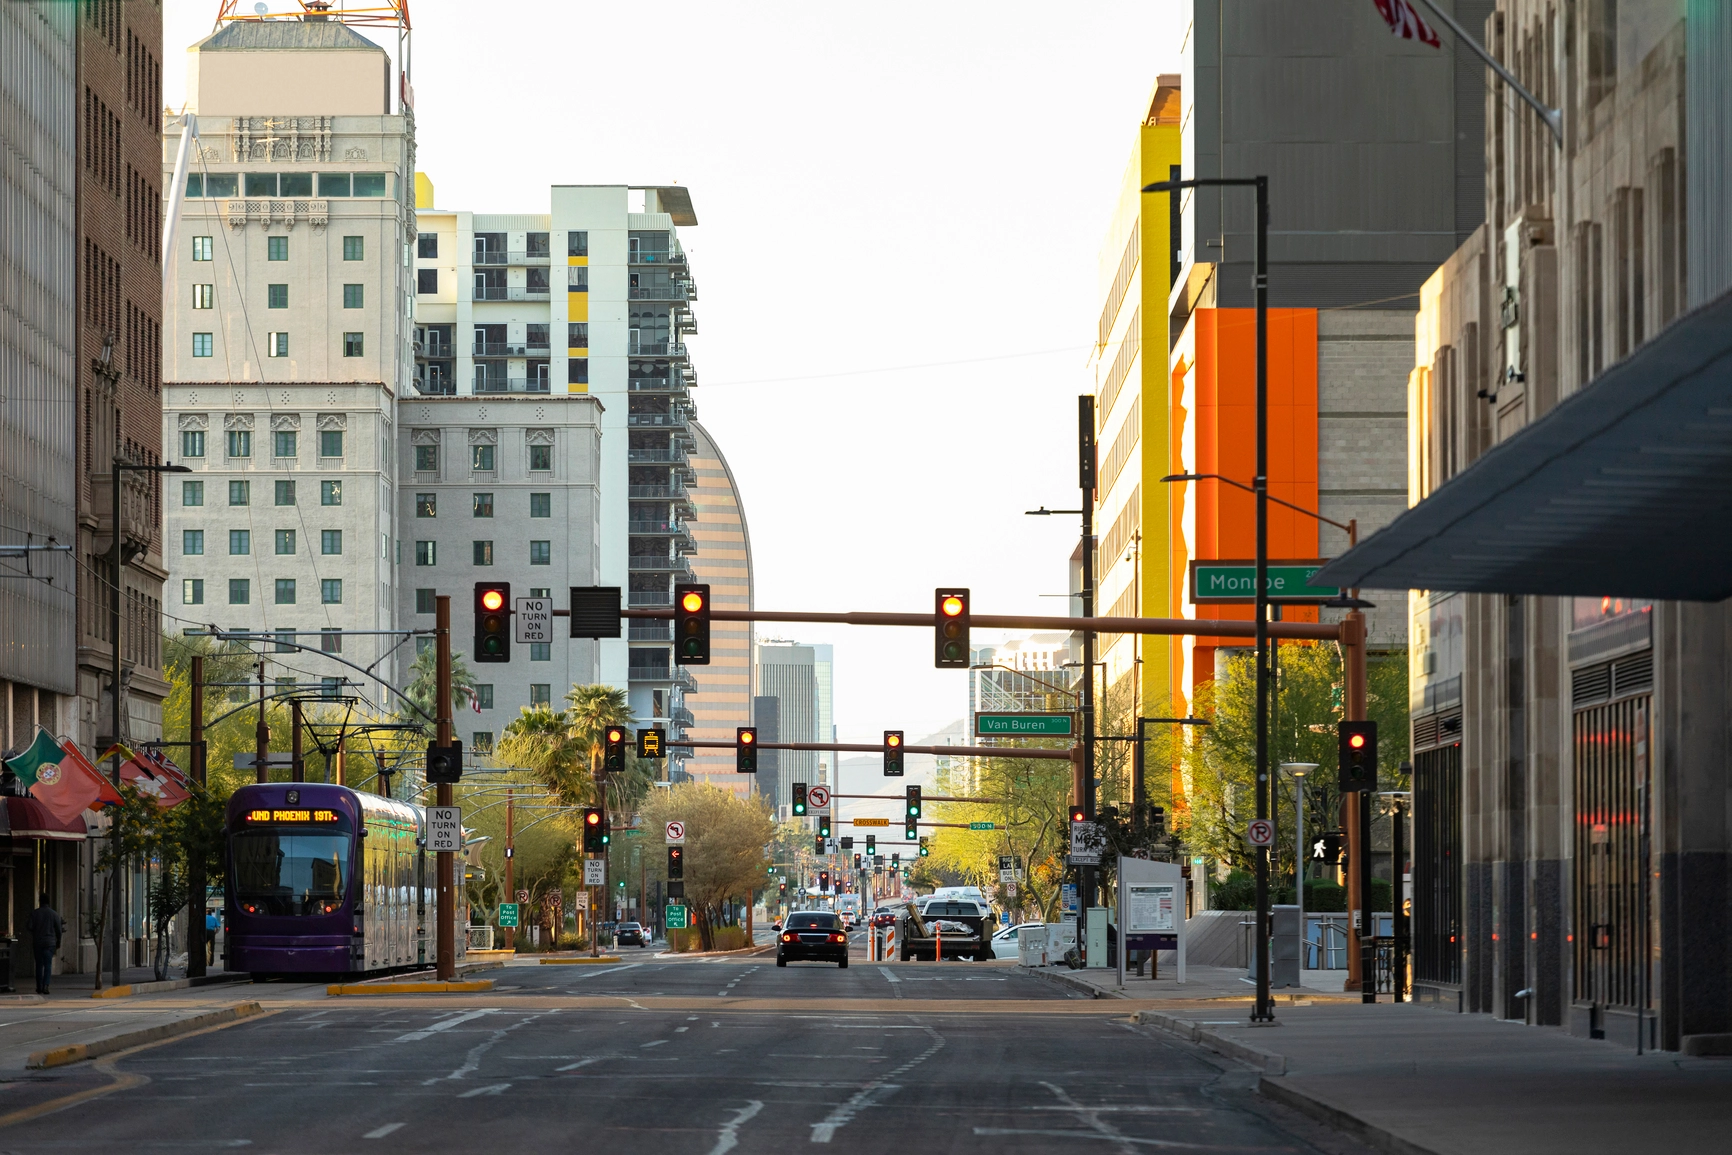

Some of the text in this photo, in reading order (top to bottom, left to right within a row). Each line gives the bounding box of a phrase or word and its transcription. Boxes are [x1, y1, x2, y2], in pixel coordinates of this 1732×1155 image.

[526, 601, 543, 611] NO
[527, 622, 541, 630] ON
[525, 632, 544, 640] RED
[987, 720, 1045, 729] Van Buren
[252, 811, 270, 821] UND
[273, 811, 310, 821] PHOENIX
[436, 811, 452, 820] NO
[434, 840, 453, 848] RED
